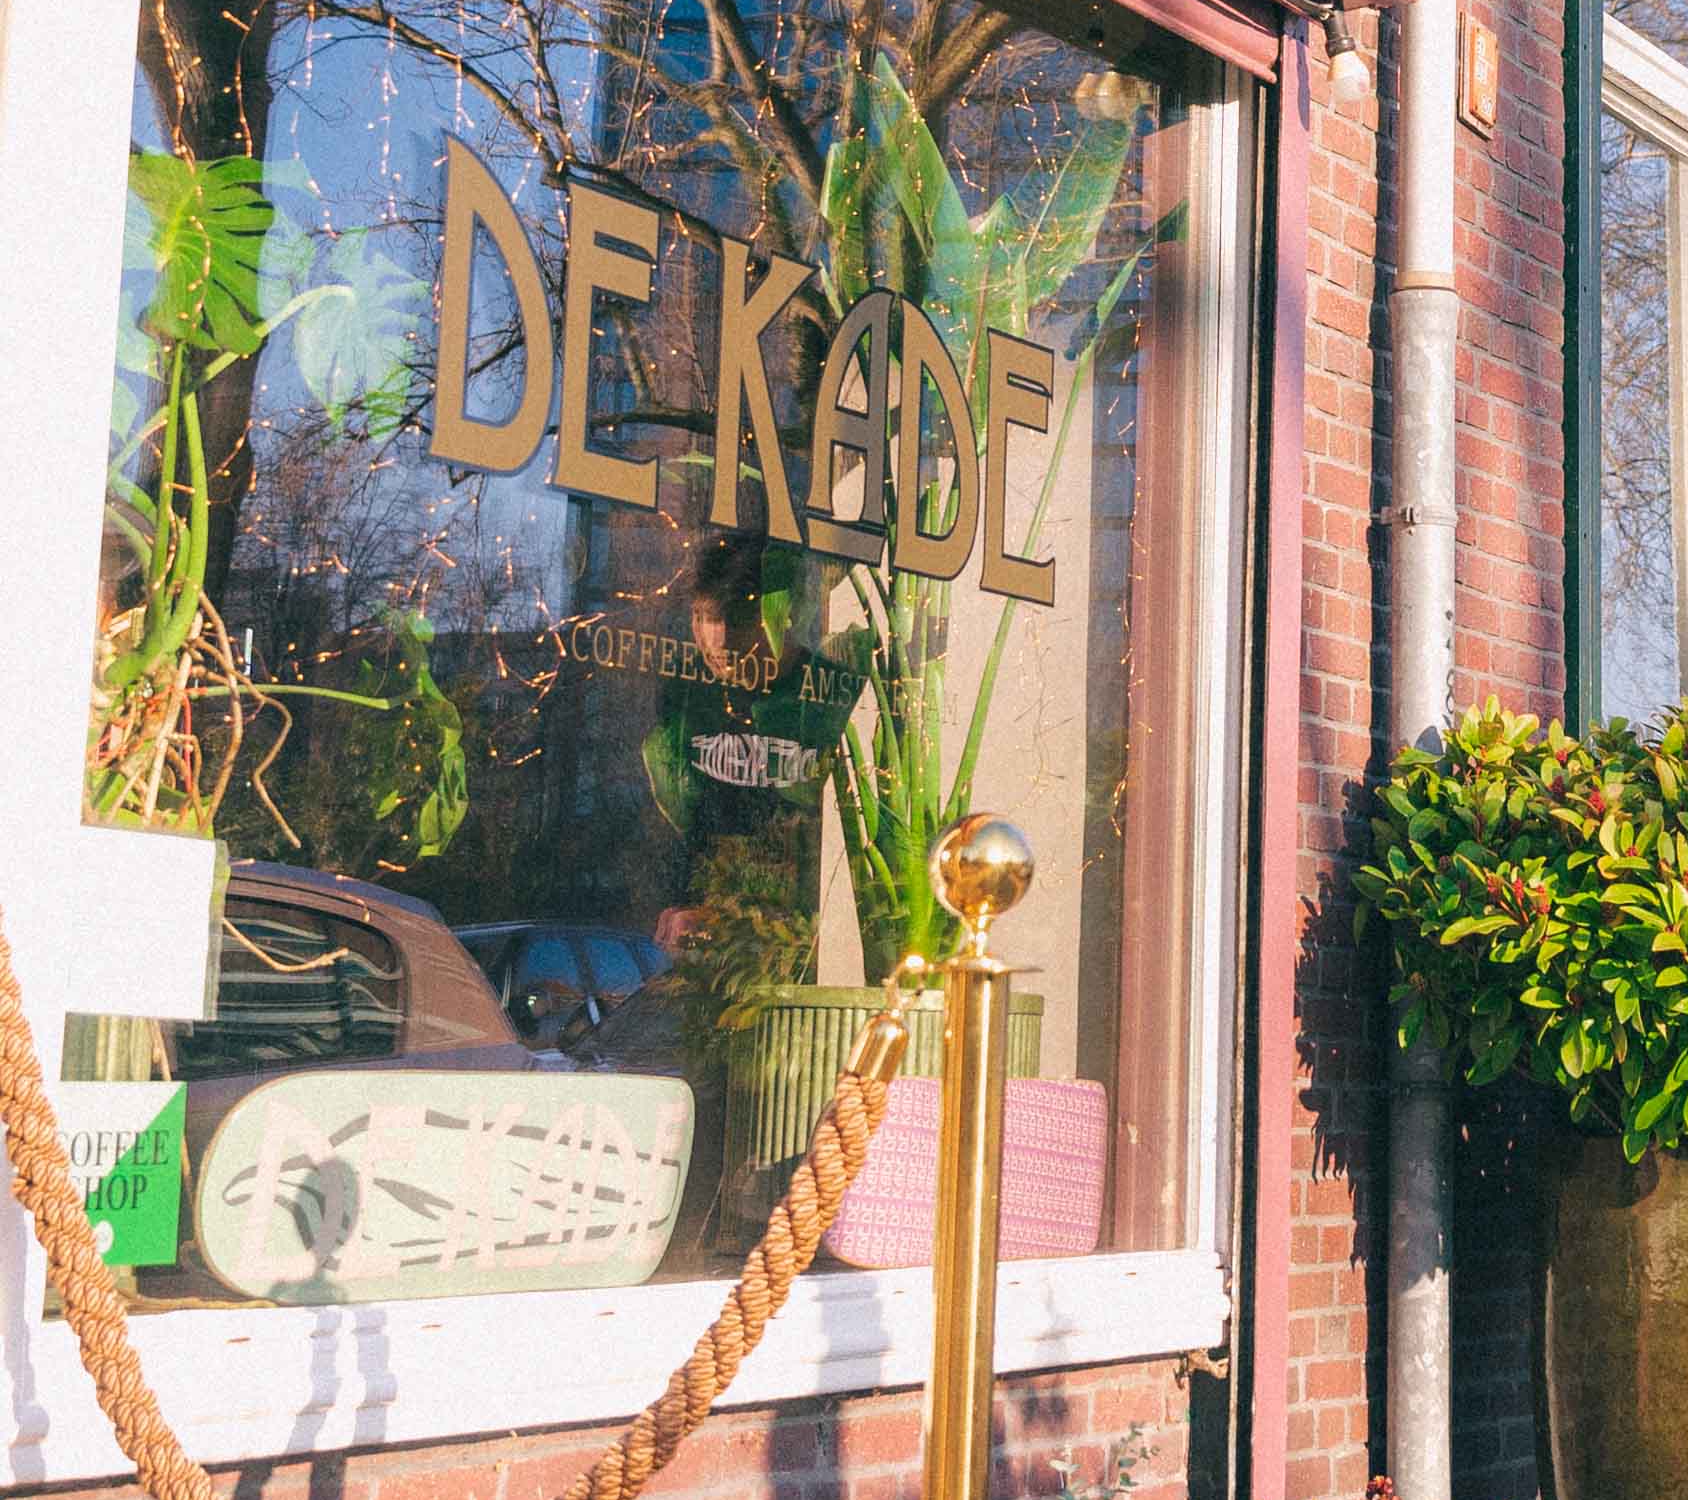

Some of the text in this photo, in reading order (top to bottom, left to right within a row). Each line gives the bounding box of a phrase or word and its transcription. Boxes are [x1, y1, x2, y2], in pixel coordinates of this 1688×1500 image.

[429, 132, 1056, 608] DE KADE
[572, 625, 779, 694] COFFEESHOP
[62, 1129, 170, 1167] OFFEE
[75, 1174, 148, 1211] HOP
[236, 1102, 426, 1282] DE
